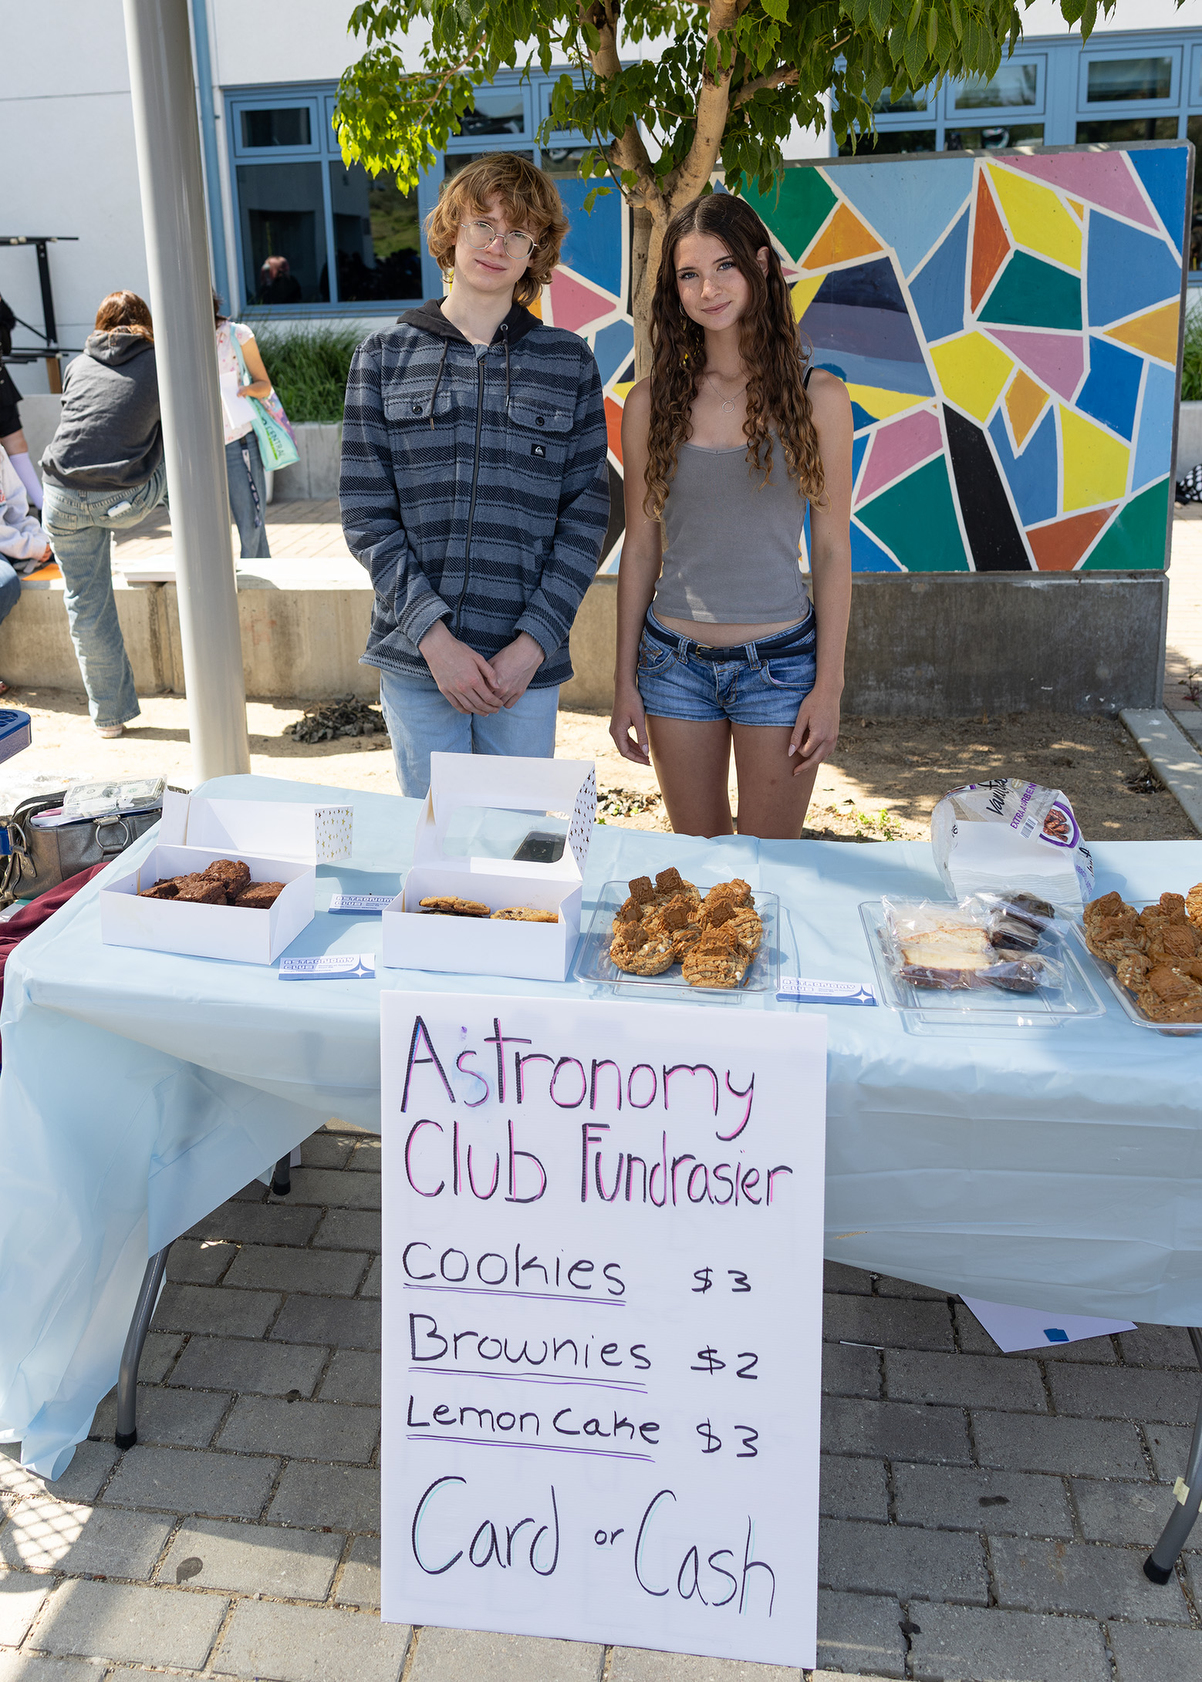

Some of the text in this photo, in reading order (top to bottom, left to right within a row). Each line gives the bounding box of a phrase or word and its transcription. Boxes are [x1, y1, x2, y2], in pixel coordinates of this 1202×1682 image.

[400, 1015, 755, 1141] Astronomy
[405, 1119, 793, 1207] Club Fundrasier
[402, 1241, 626, 1296] Cookies
[409, 1313, 651, 1370] Brownies
[406, 1395, 540, 1436] Lemon
[552, 1408, 660, 1444] Cake
[411, 1475, 776, 1617] Card or Cash
